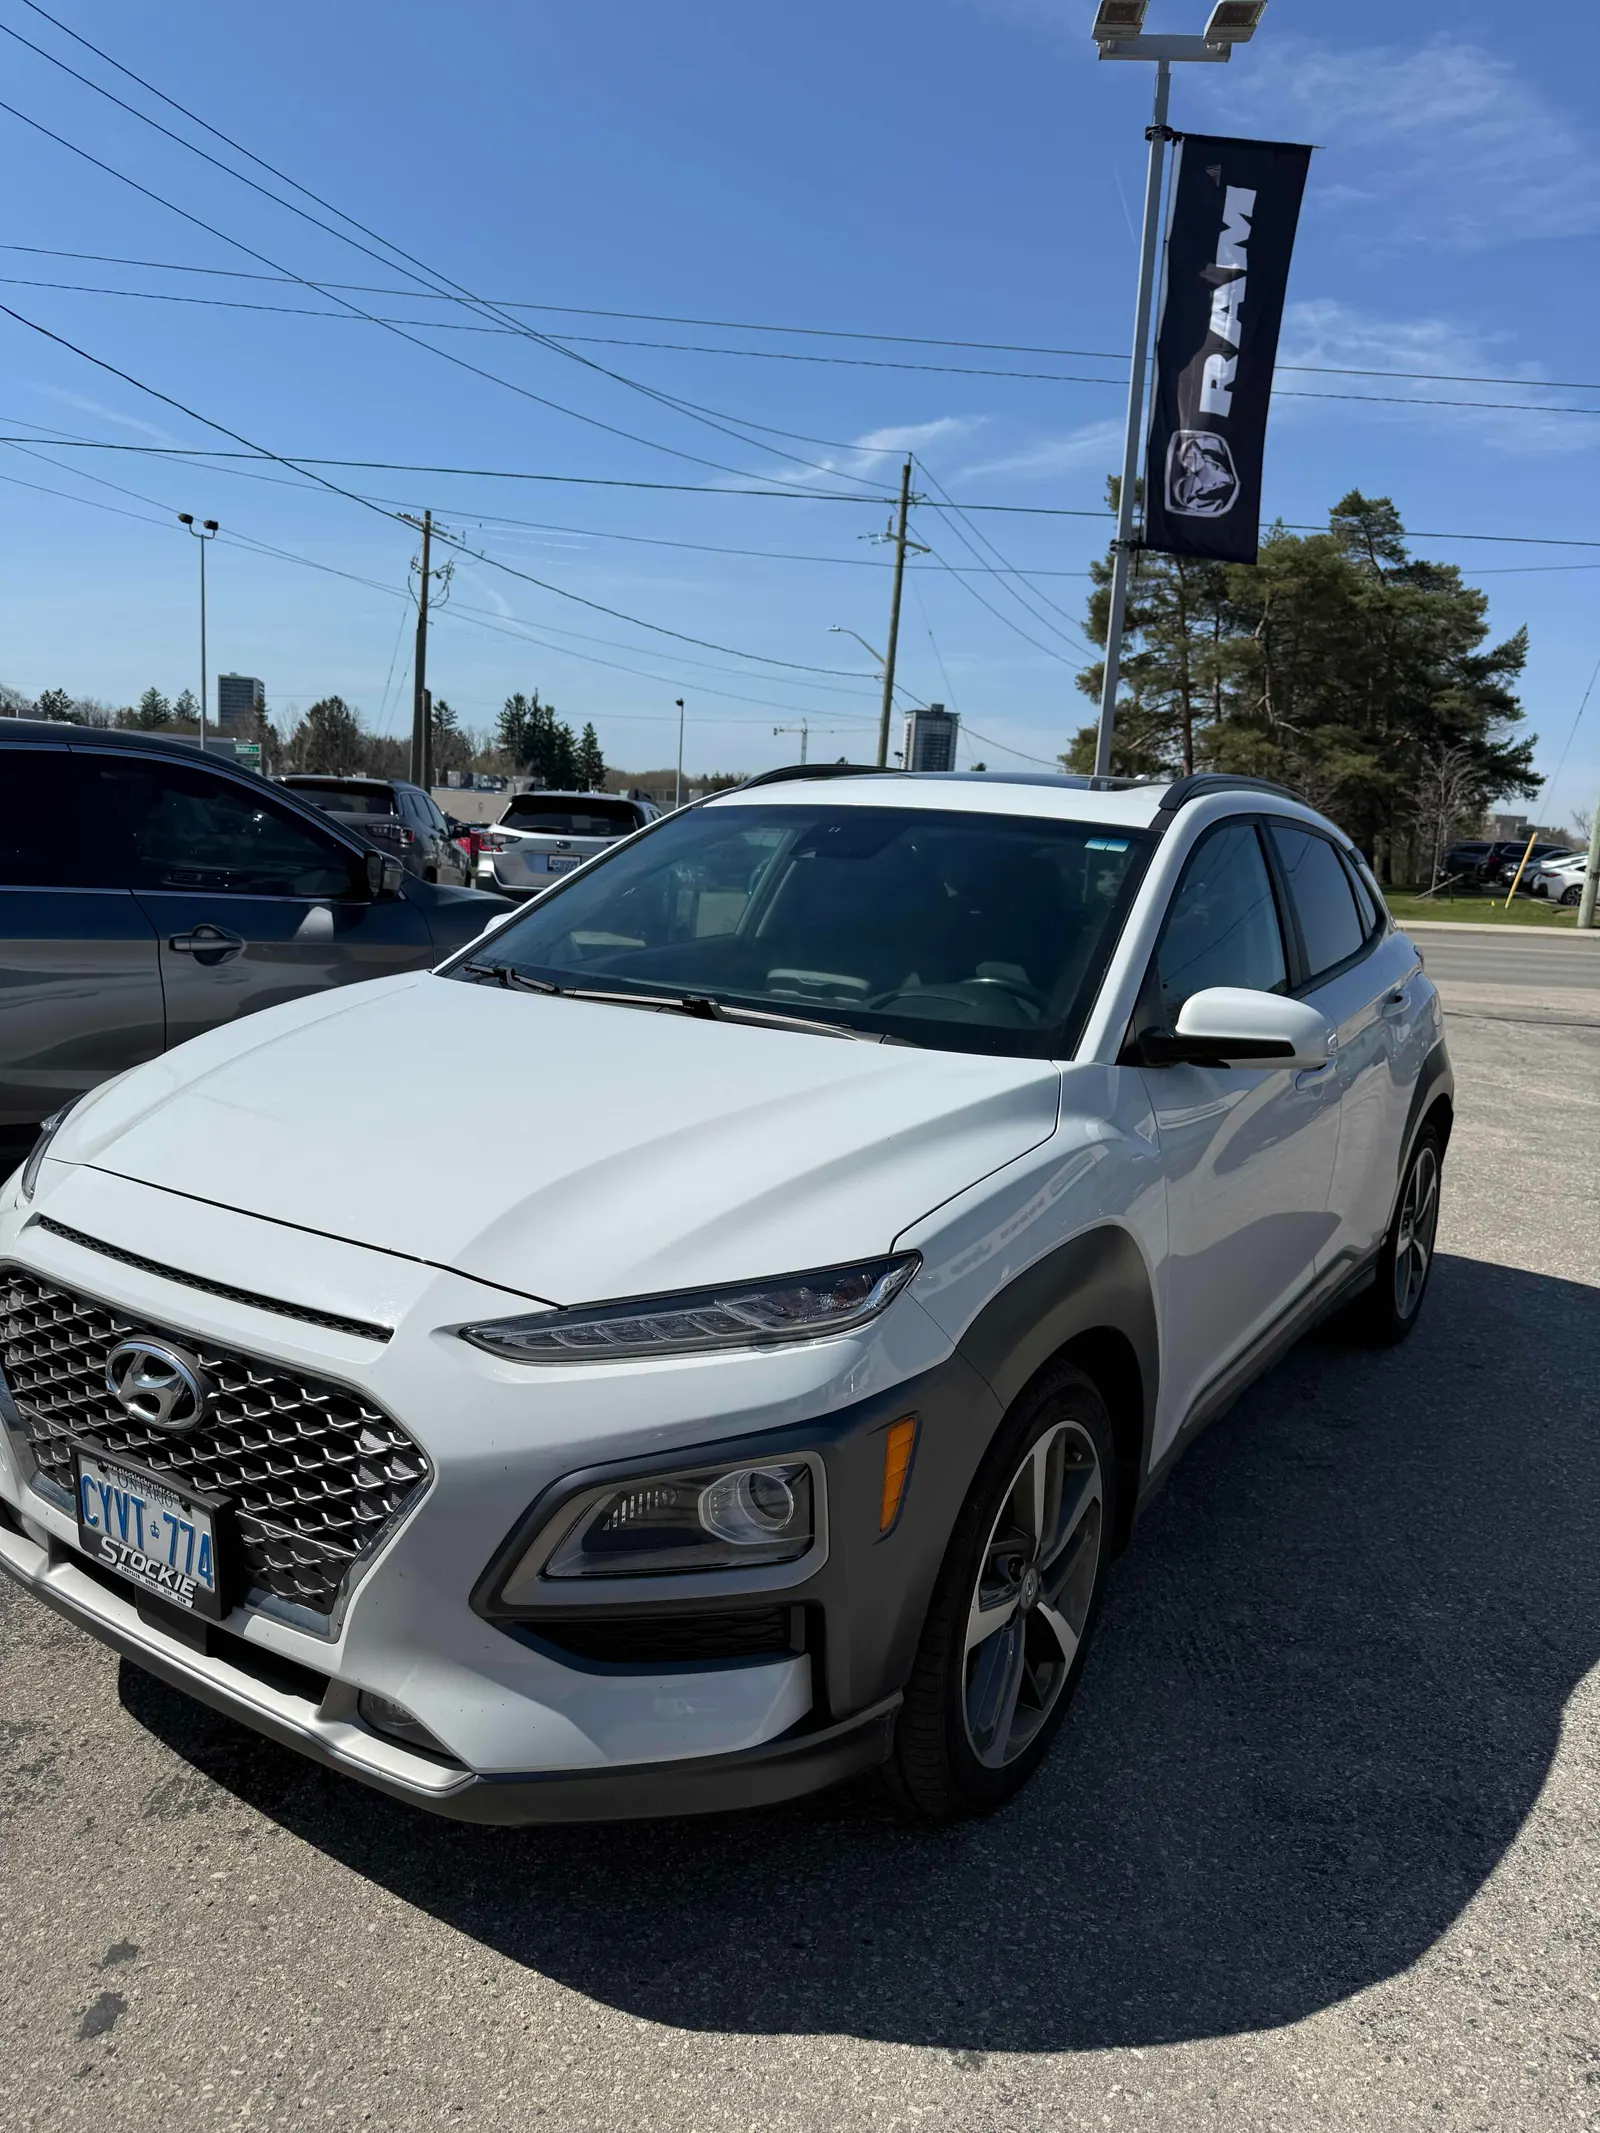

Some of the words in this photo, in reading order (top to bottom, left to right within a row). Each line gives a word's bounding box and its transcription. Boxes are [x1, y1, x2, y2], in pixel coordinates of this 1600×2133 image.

[1199, 185, 1257, 418] RAM
[102, 1460, 180, 1501] www.stockiechrysler.com
[81, 1473, 146, 1551] CYVT
[163, 1510, 213, 1589] 774
[98, 1536, 197, 1598] STOCKIE
